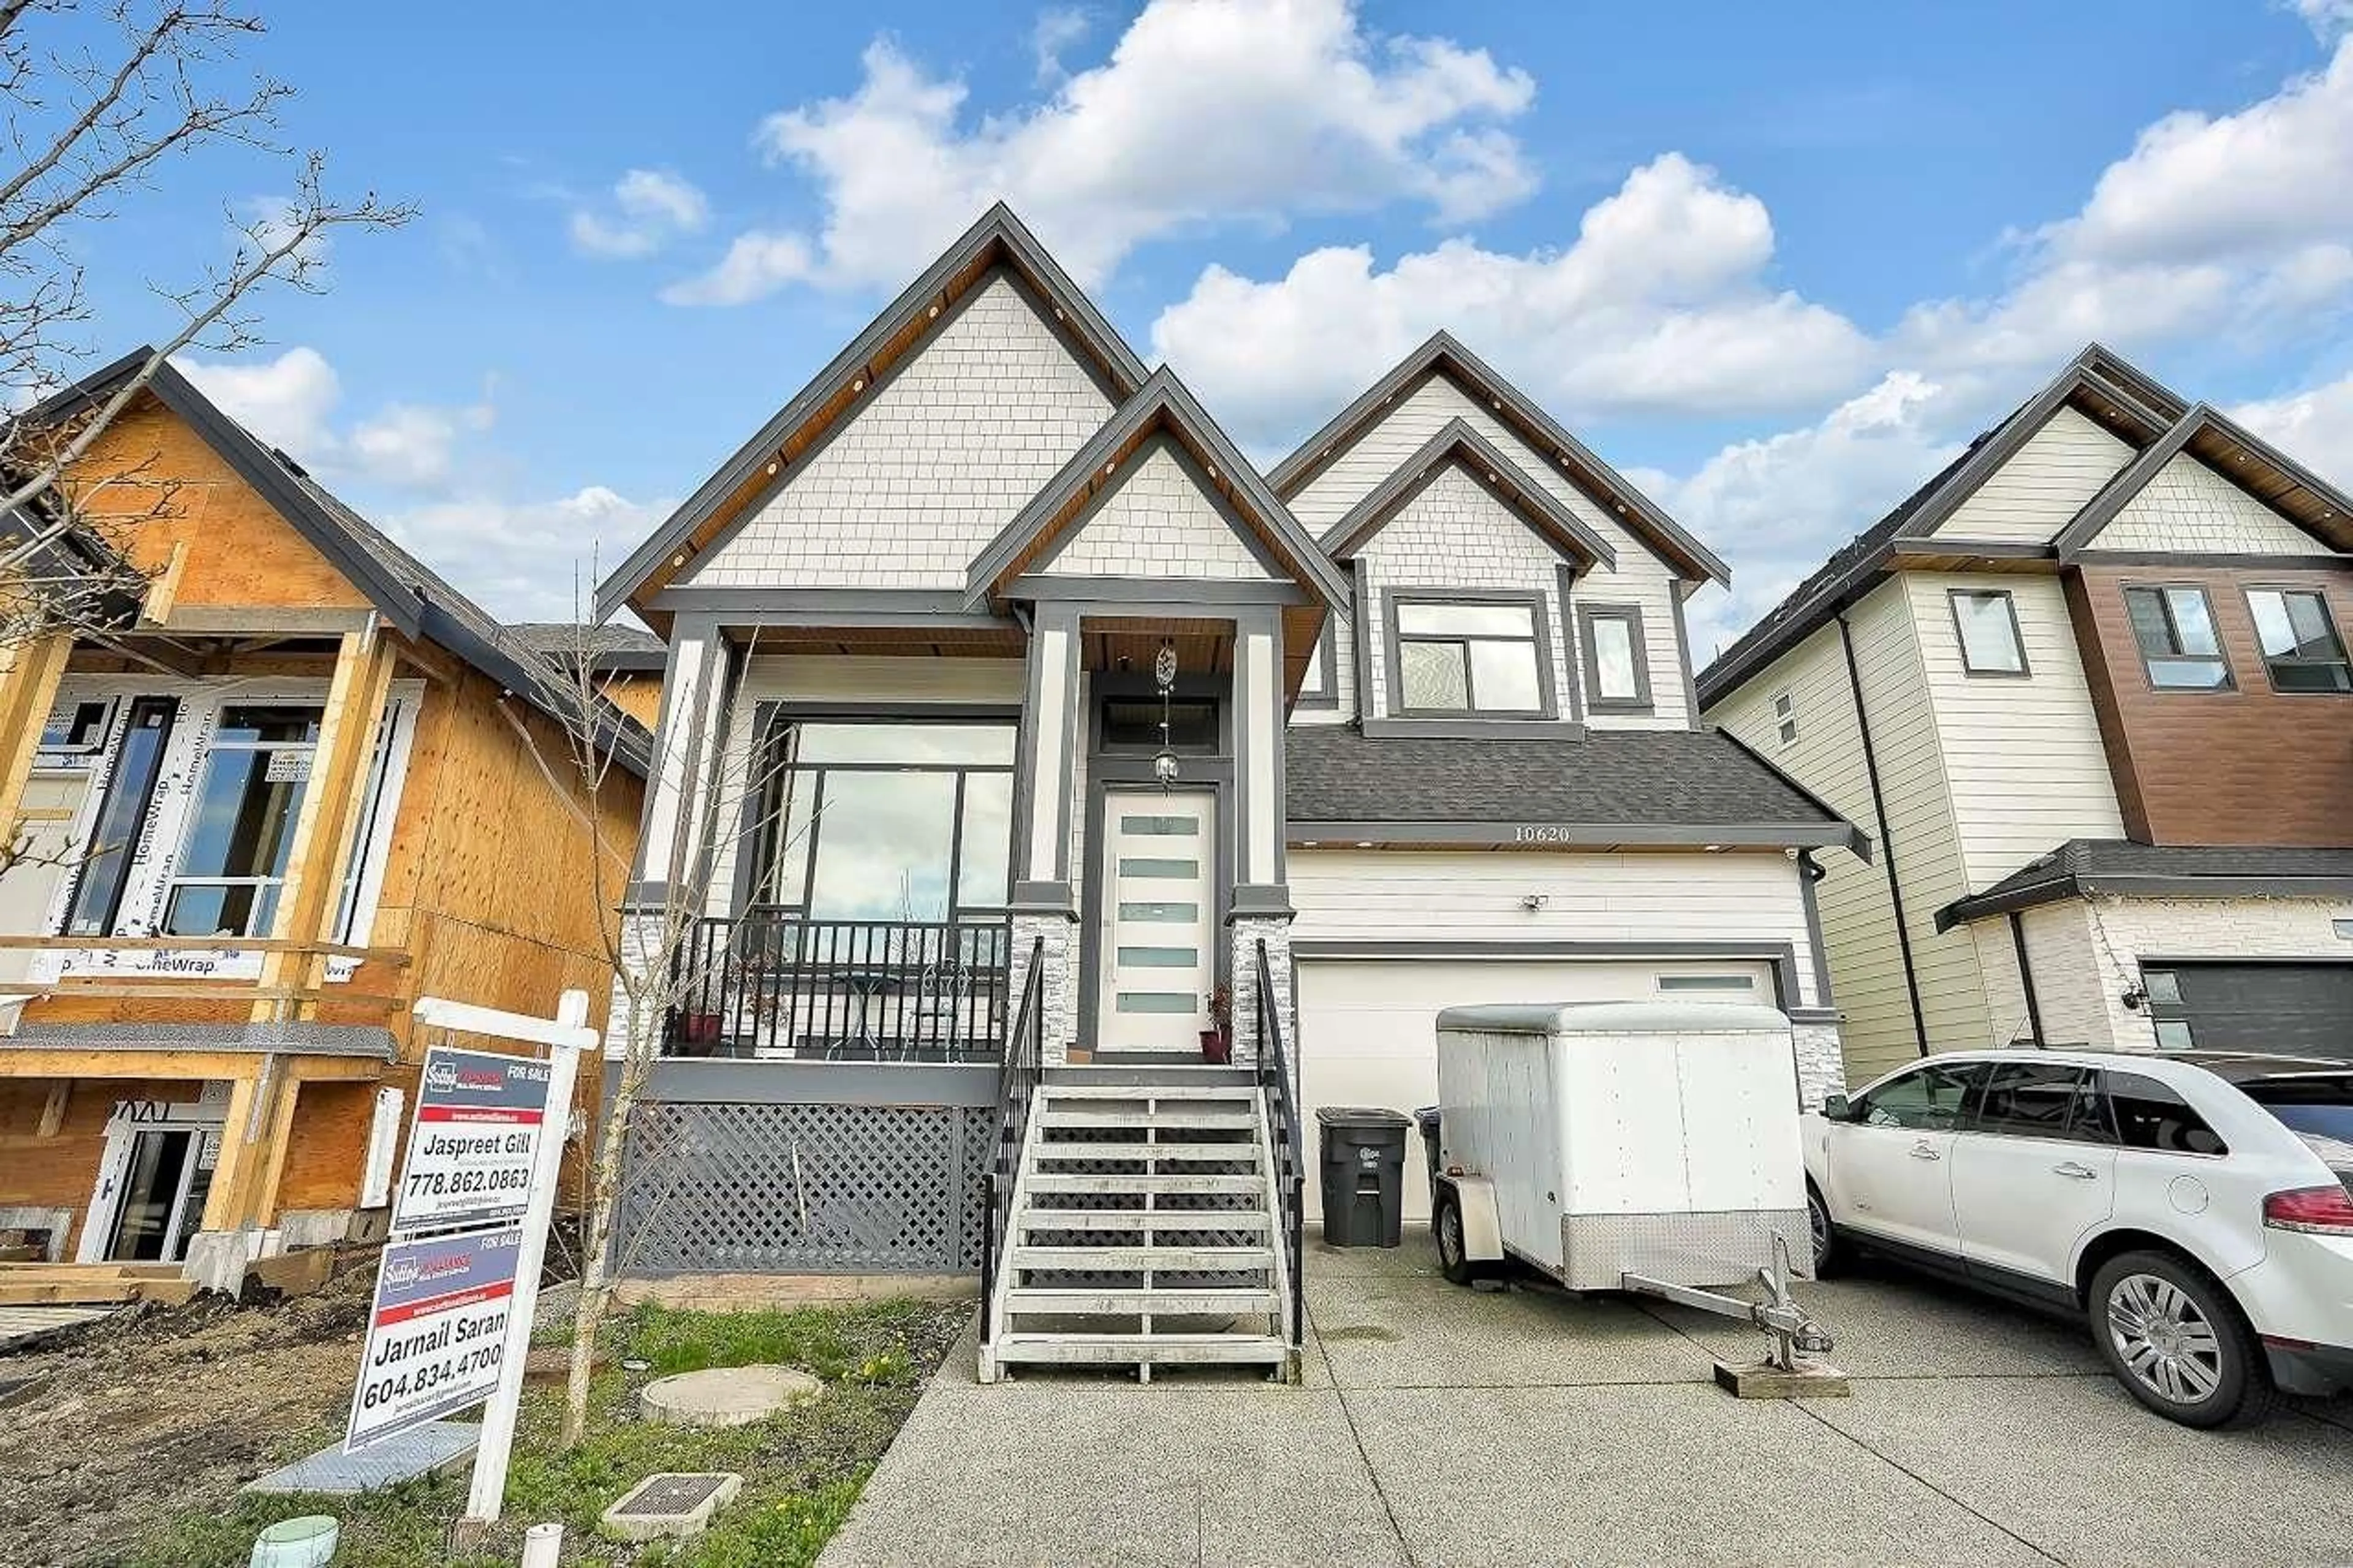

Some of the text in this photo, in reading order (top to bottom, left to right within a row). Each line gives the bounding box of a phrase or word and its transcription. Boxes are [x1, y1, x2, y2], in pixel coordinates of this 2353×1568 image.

[1515, 827, 1569, 841] 10620
[507, 1065, 550, 1082] FOR SALE
[423, 1132, 531, 1161] Jaspreet Gill
[409, 1168, 529, 1197] 778.862.0863
[480, 1232, 521, 1251] FOR SALE
[374, 1312, 504, 1366] Jarnail Saran
[364, 1343, 501, 1409] 604.834.4700
